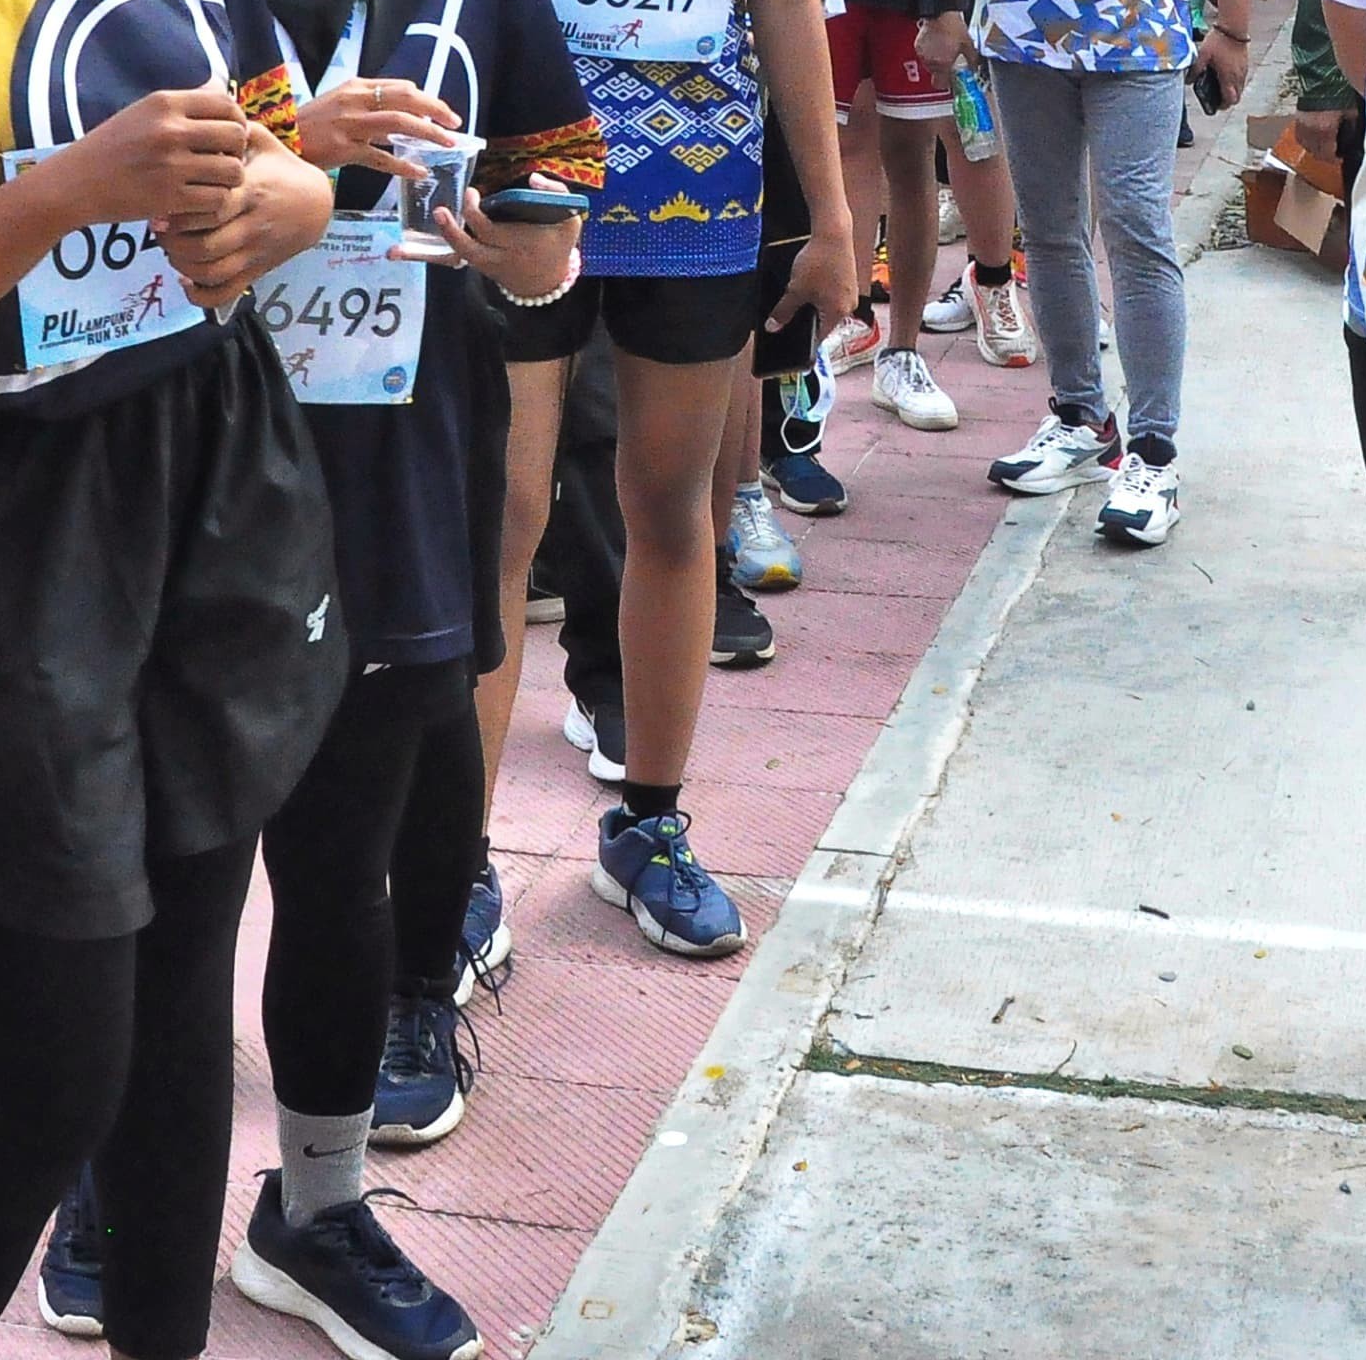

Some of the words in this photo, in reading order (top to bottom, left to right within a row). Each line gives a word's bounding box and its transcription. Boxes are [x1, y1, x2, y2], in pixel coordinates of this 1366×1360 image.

[42, 308, 78, 342] PU
[78, 309, 135, 334] LAMPUNG
[255, 283, 401, 338] 6495
[87, 329, 111, 346] RUN
